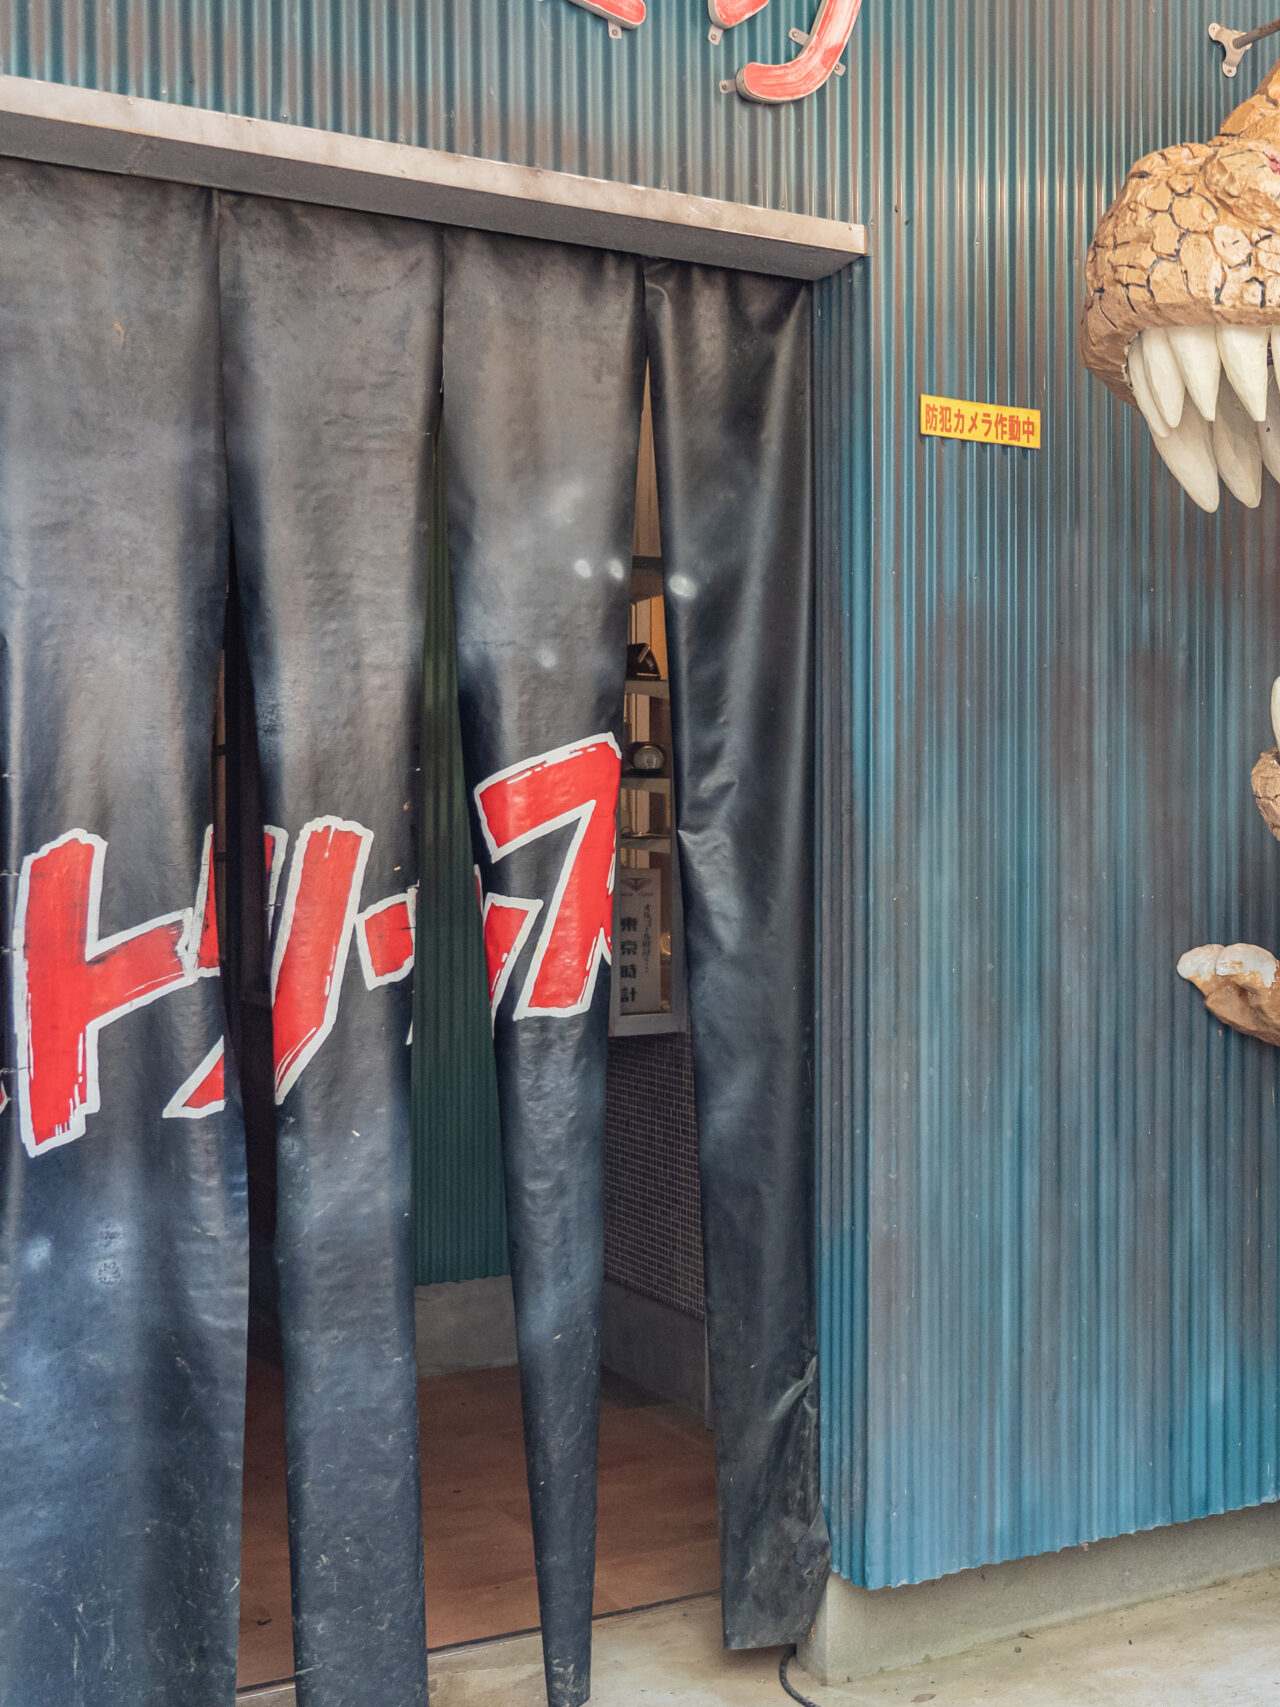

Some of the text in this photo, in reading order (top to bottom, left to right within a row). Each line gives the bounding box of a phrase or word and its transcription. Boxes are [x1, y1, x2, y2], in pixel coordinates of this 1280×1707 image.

[925, 403, 1035, 443] 防犯カメラ作動中
[620, 916, 637, 1003] 東京時計
